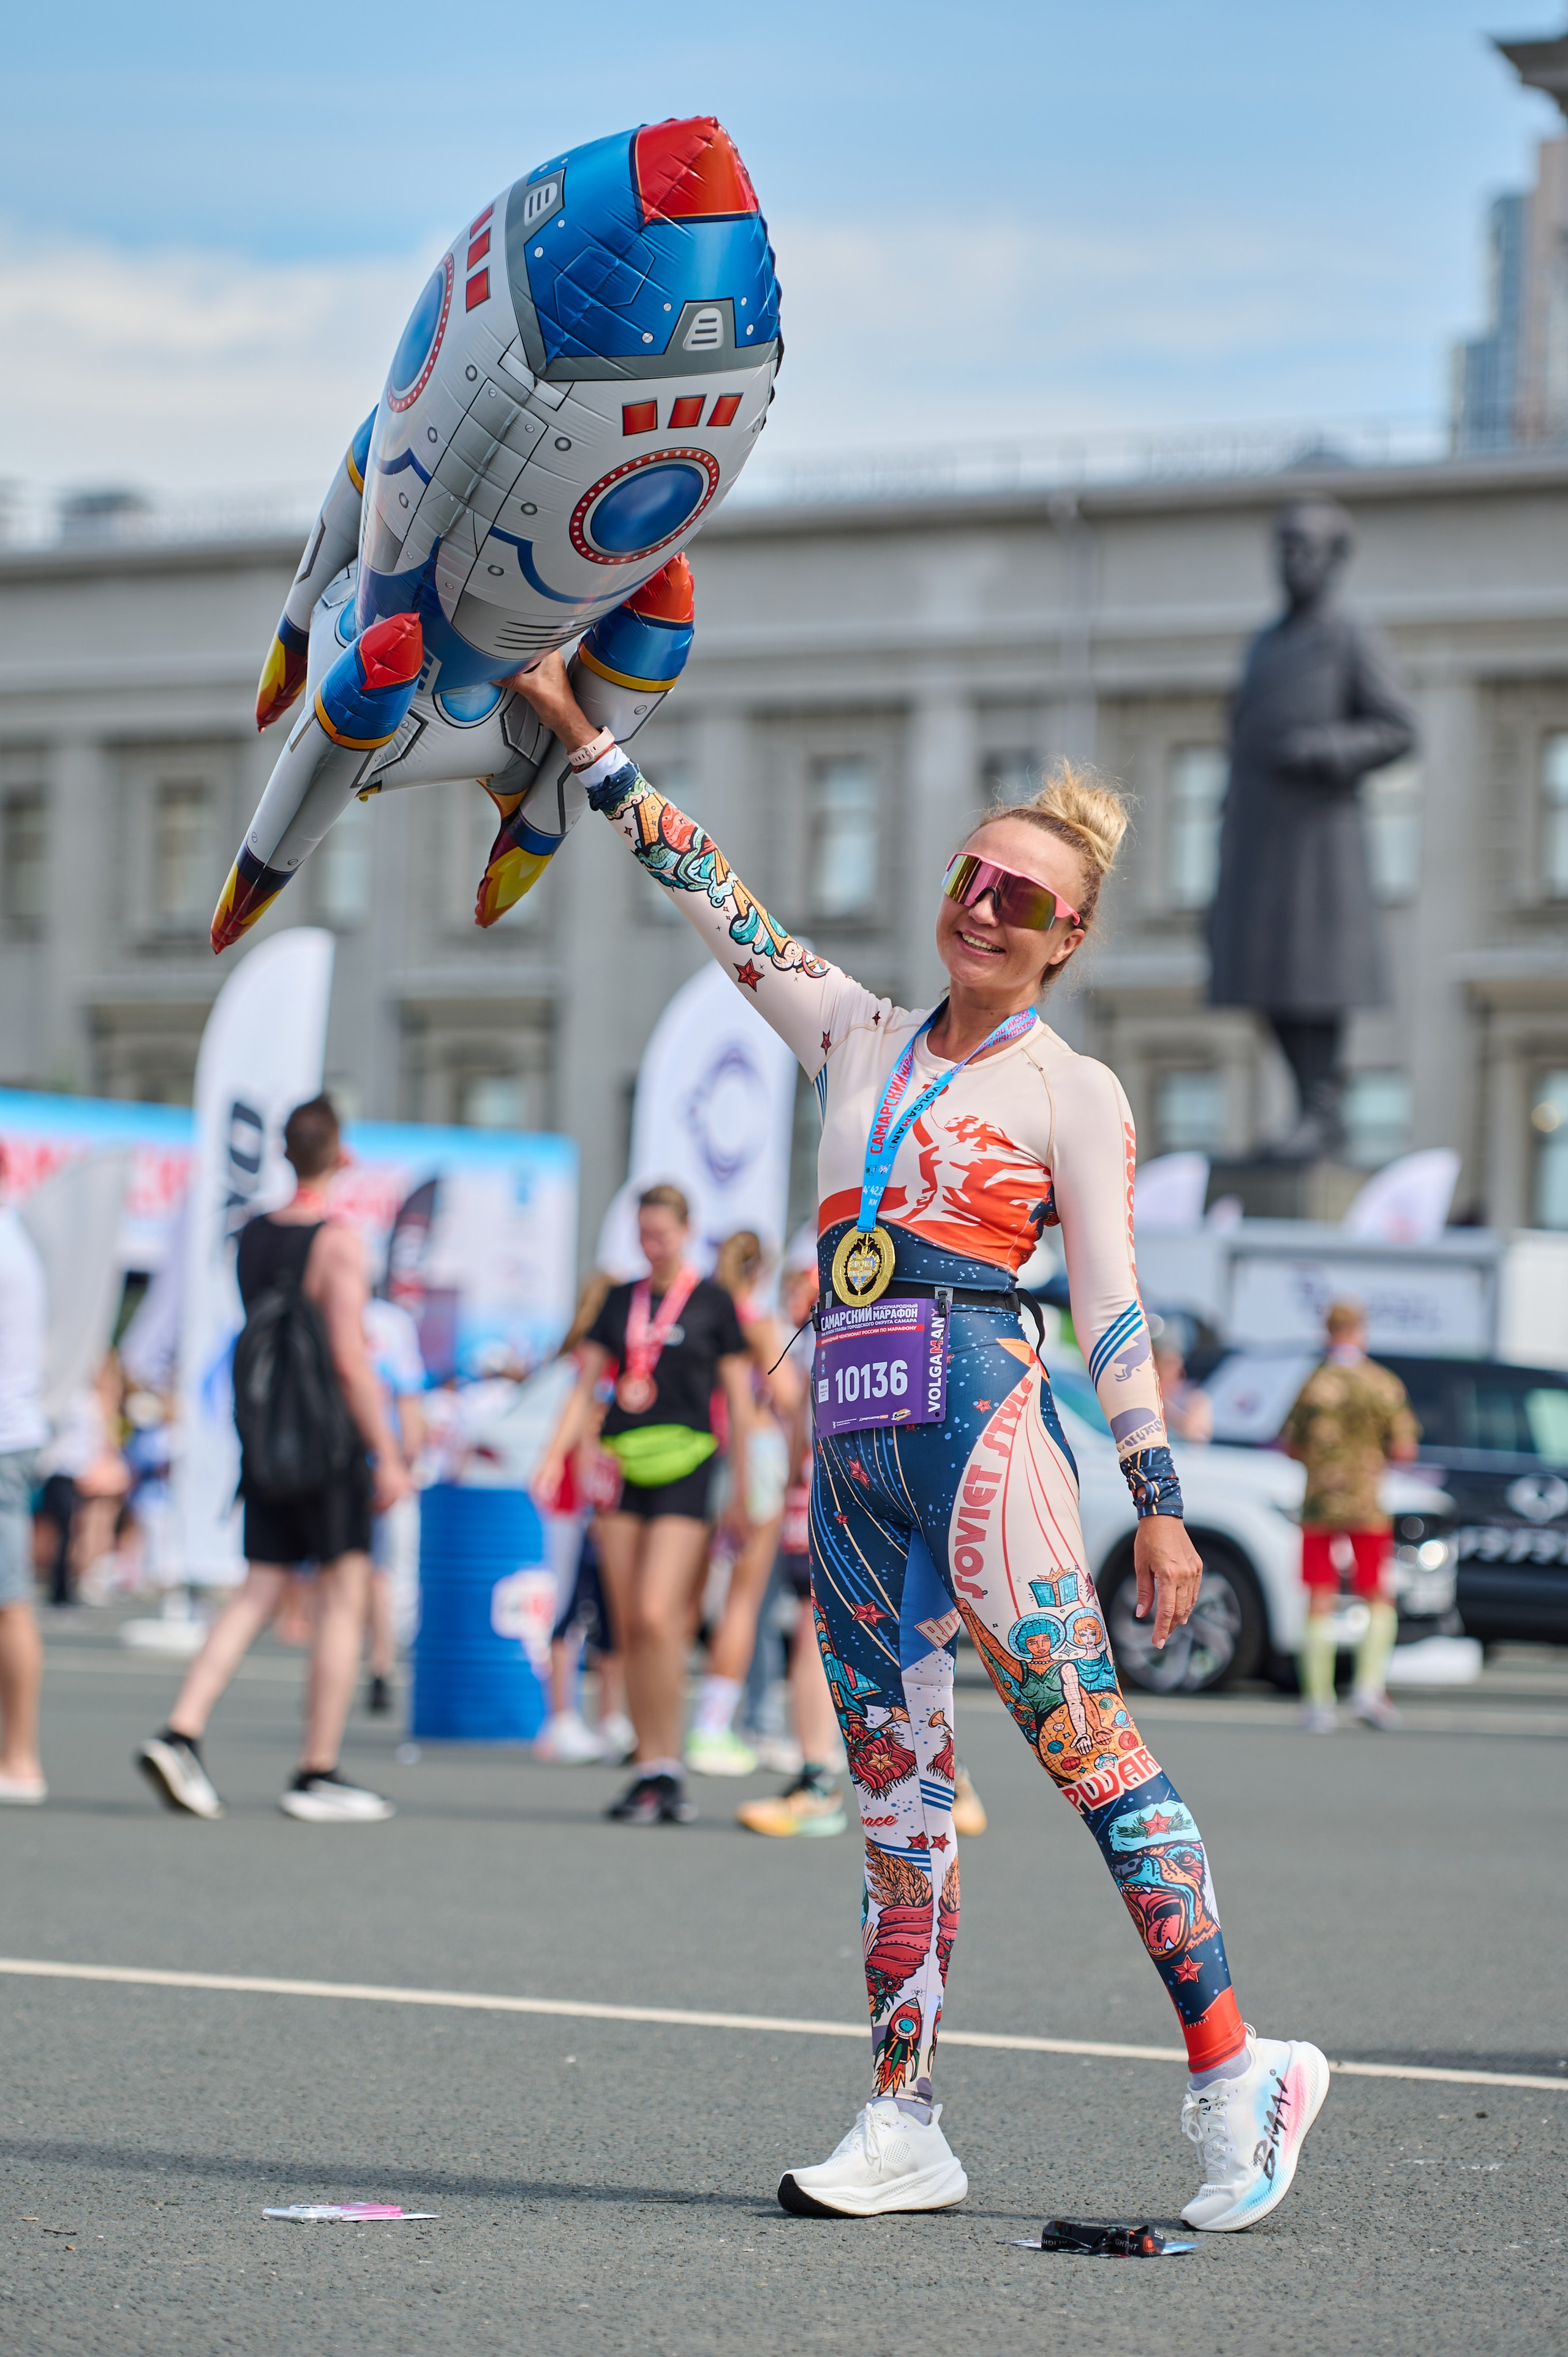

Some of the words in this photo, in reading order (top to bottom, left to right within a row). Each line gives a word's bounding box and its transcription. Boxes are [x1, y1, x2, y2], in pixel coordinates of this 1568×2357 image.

[870, 1072, 907, 1154] САМАРСКИЙ
[821, 1305, 872, 1332] САМАРСКИЙ
[873, 1308, 918, 1321] МАРАФОН
[847, 1321, 874, 1330] ГОРОДСКОГО
[835, 1359, 908, 1404] 10136
[928, 1316, 944, 1413] VOLGAMAN
[954, 1464, 1003, 1599] SOVIET
